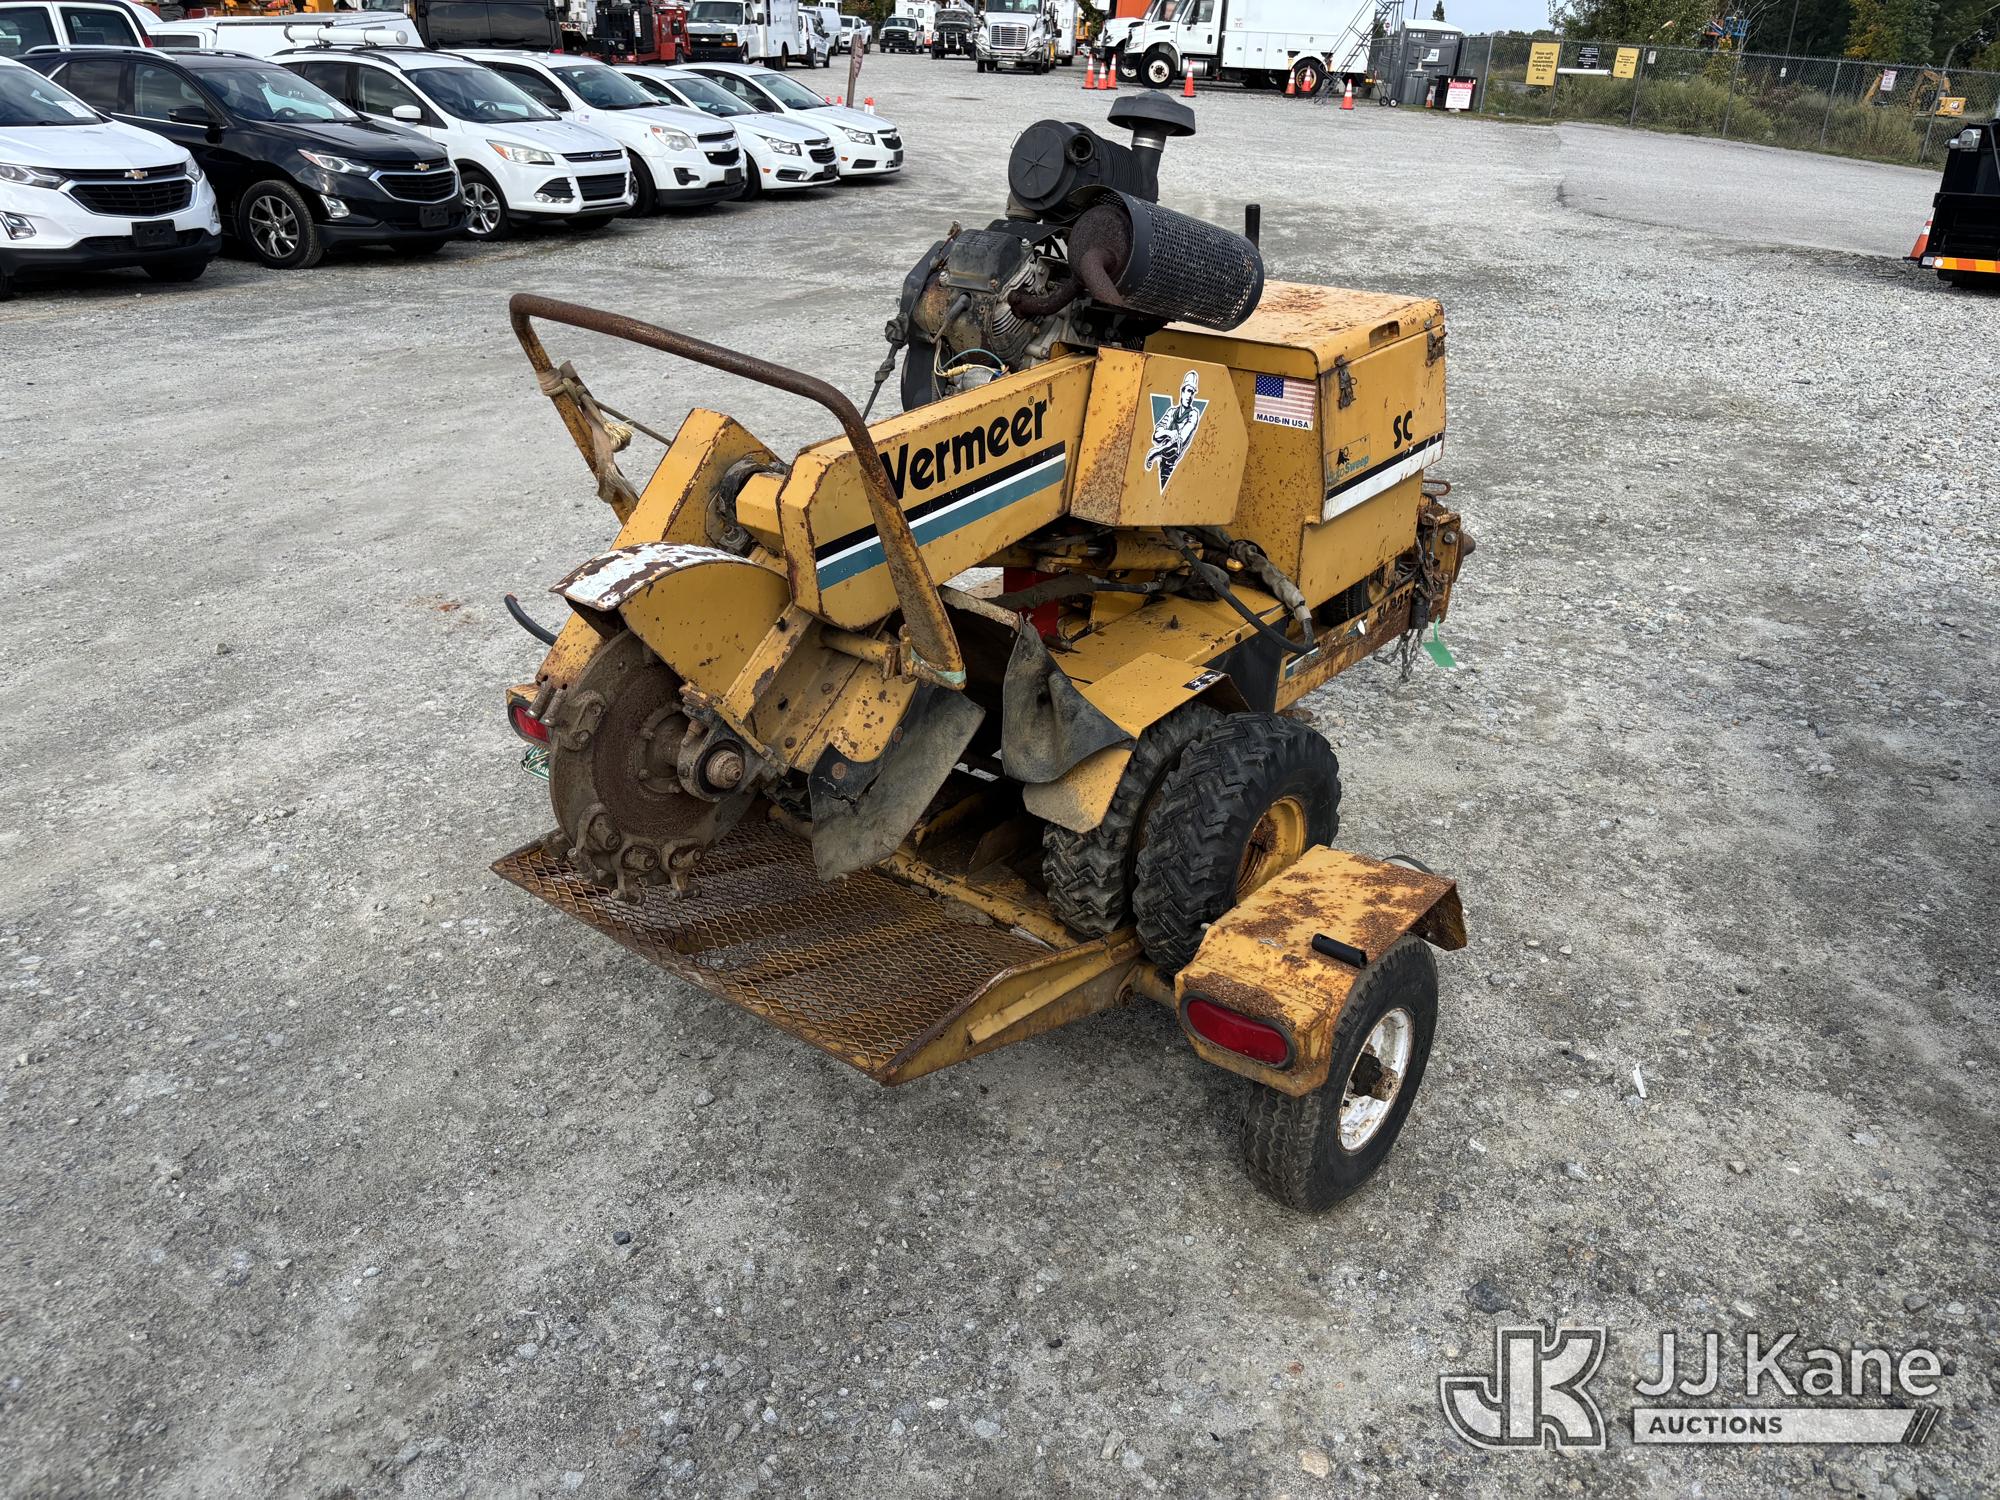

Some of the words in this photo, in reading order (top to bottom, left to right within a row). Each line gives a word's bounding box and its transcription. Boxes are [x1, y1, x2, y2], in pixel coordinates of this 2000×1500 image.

[1256, 413, 1280, 423] MADE
[1282, 417, 1290, 425] IN
[1292, 420, 1309, 428] USA
[1393, 410, 1412, 449] SC
[879, 399, 1047, 500] Vermeer
